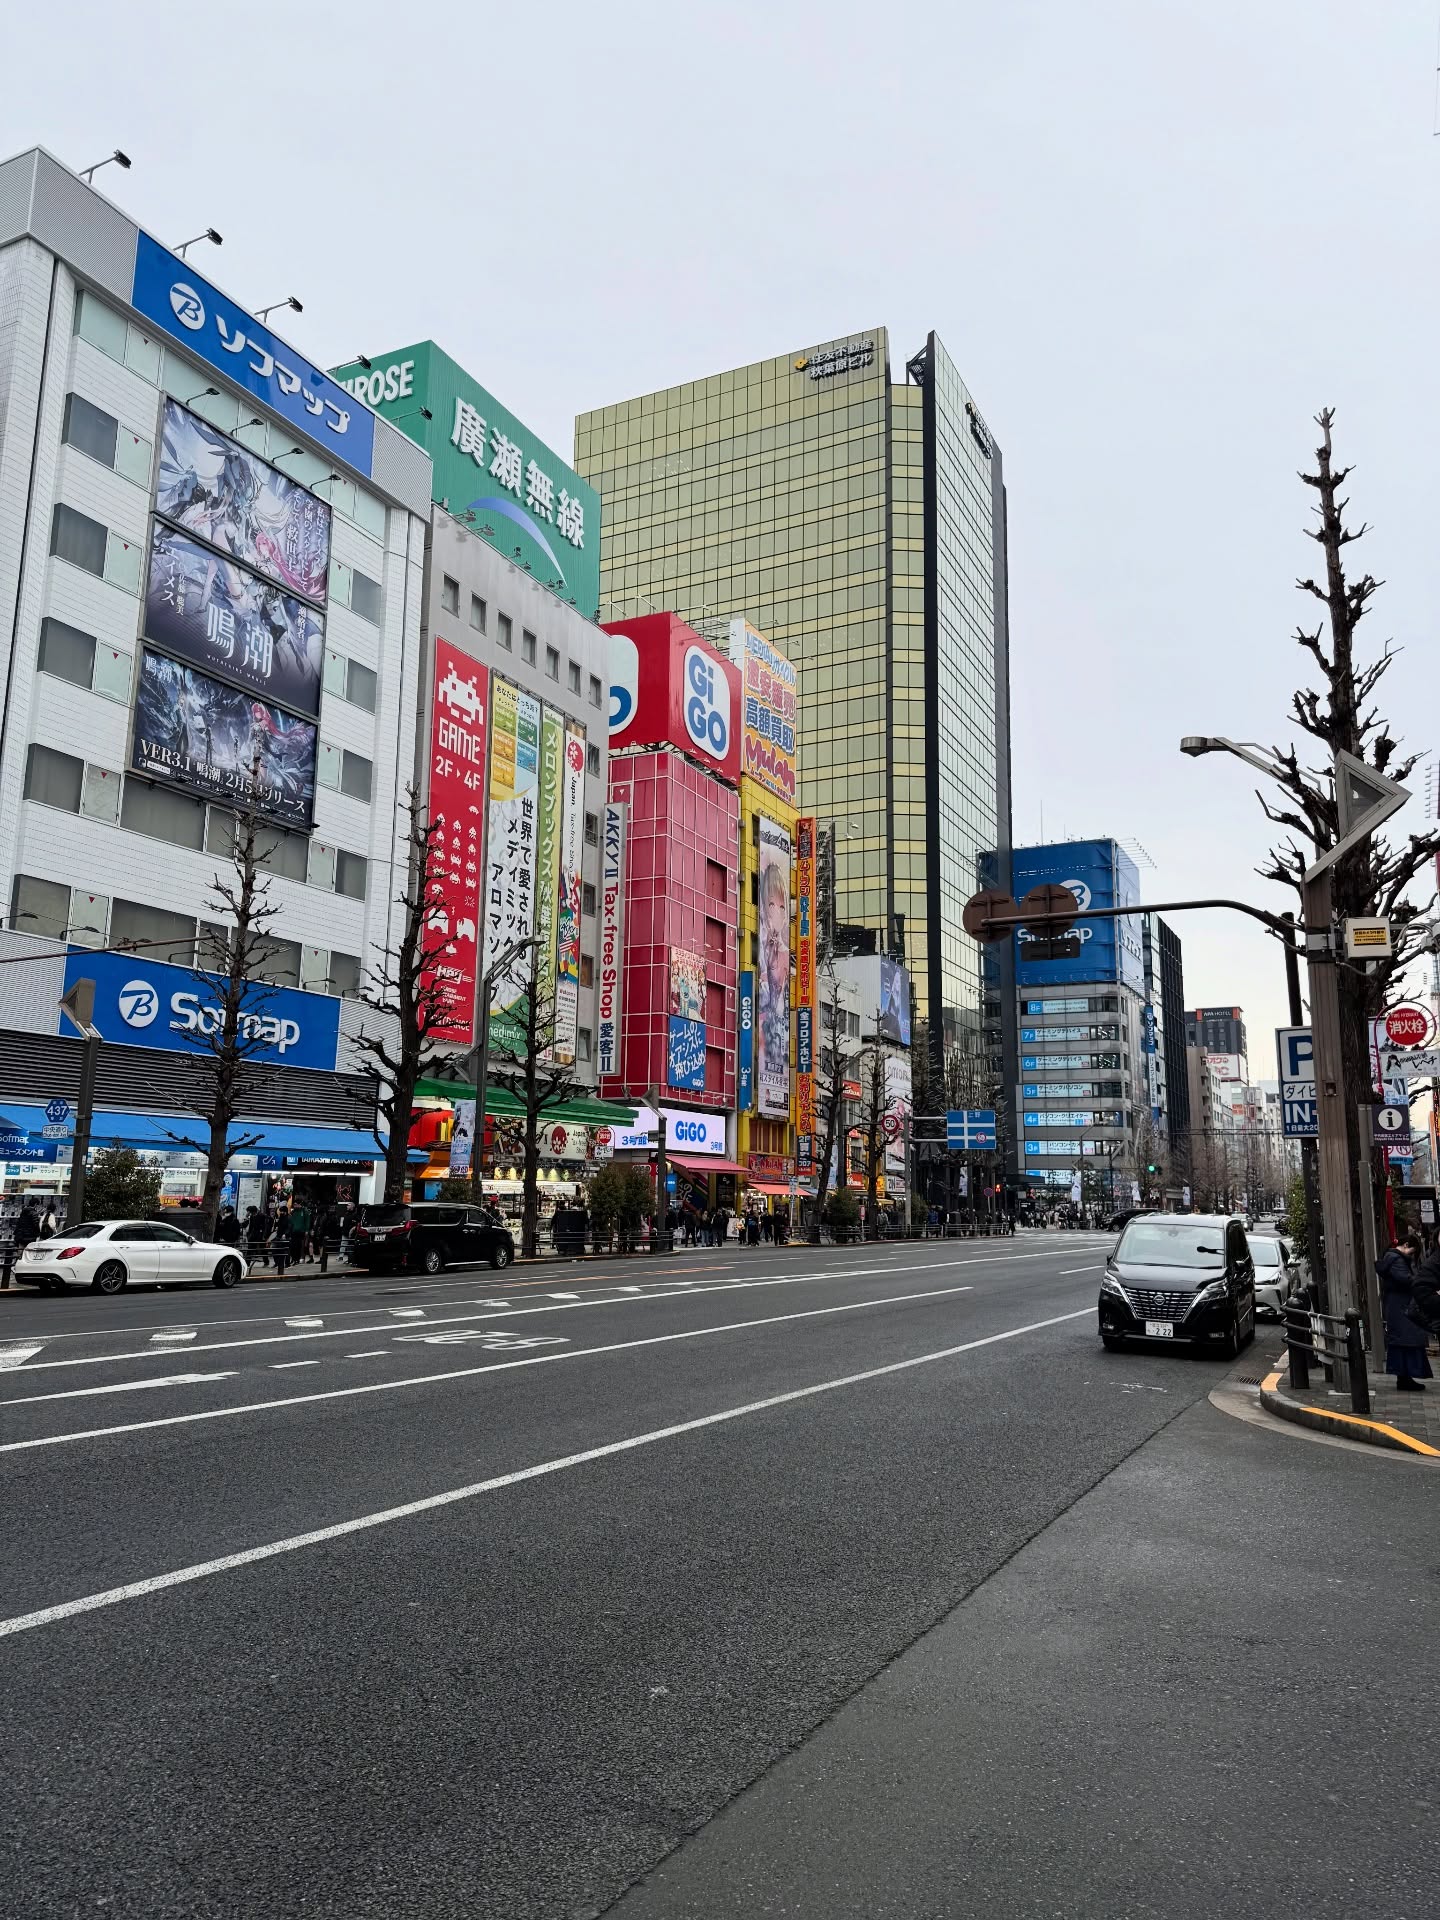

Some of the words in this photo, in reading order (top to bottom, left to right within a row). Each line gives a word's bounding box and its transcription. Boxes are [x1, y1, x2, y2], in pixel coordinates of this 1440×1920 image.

[810, 338, 874, 365] 住友不動産
[810, 353, 873, 379] 秋葉原ビル
[215, 313, 351, 434] ソフマップ
[207, 602, 274, 678] 鳴潮
[688, 696, 727, 752] GO
[746, 697, 795, 753] 高額買取
[140, 738, 191, 772] VER3.1
[438, 716, 481, 765] GAME
[435, 755, 453, 778] 2F
[463, 770, 481, 791] 4F
[602, 881, 619, 966] Tax-free
[599, 968, 617, 1020] Shop
[741, 996, 752, 1030] GiGO
[1389, 1018, 1425, 1035] 消火栓
[799, 1011, 810, 1073] 全フロアホビー
[1024, 1031, 1034, 1039] 7F
[1025, 1059, 1035, 1067] 6F
[1288, 1035, 1314, 1076] P
[1026, 1087, 1035, 1095] 5F
[47, 1106, 67, 1116] 437
[886, 1120, 895, 1128] 50
[1026, 1115, 1036, 1123] 4F
[1285, 1103, 1311, 1124] IN
[675, 1120, 707, 1143] GiGO
[1028, 1144, 1038, 1152] 3F
